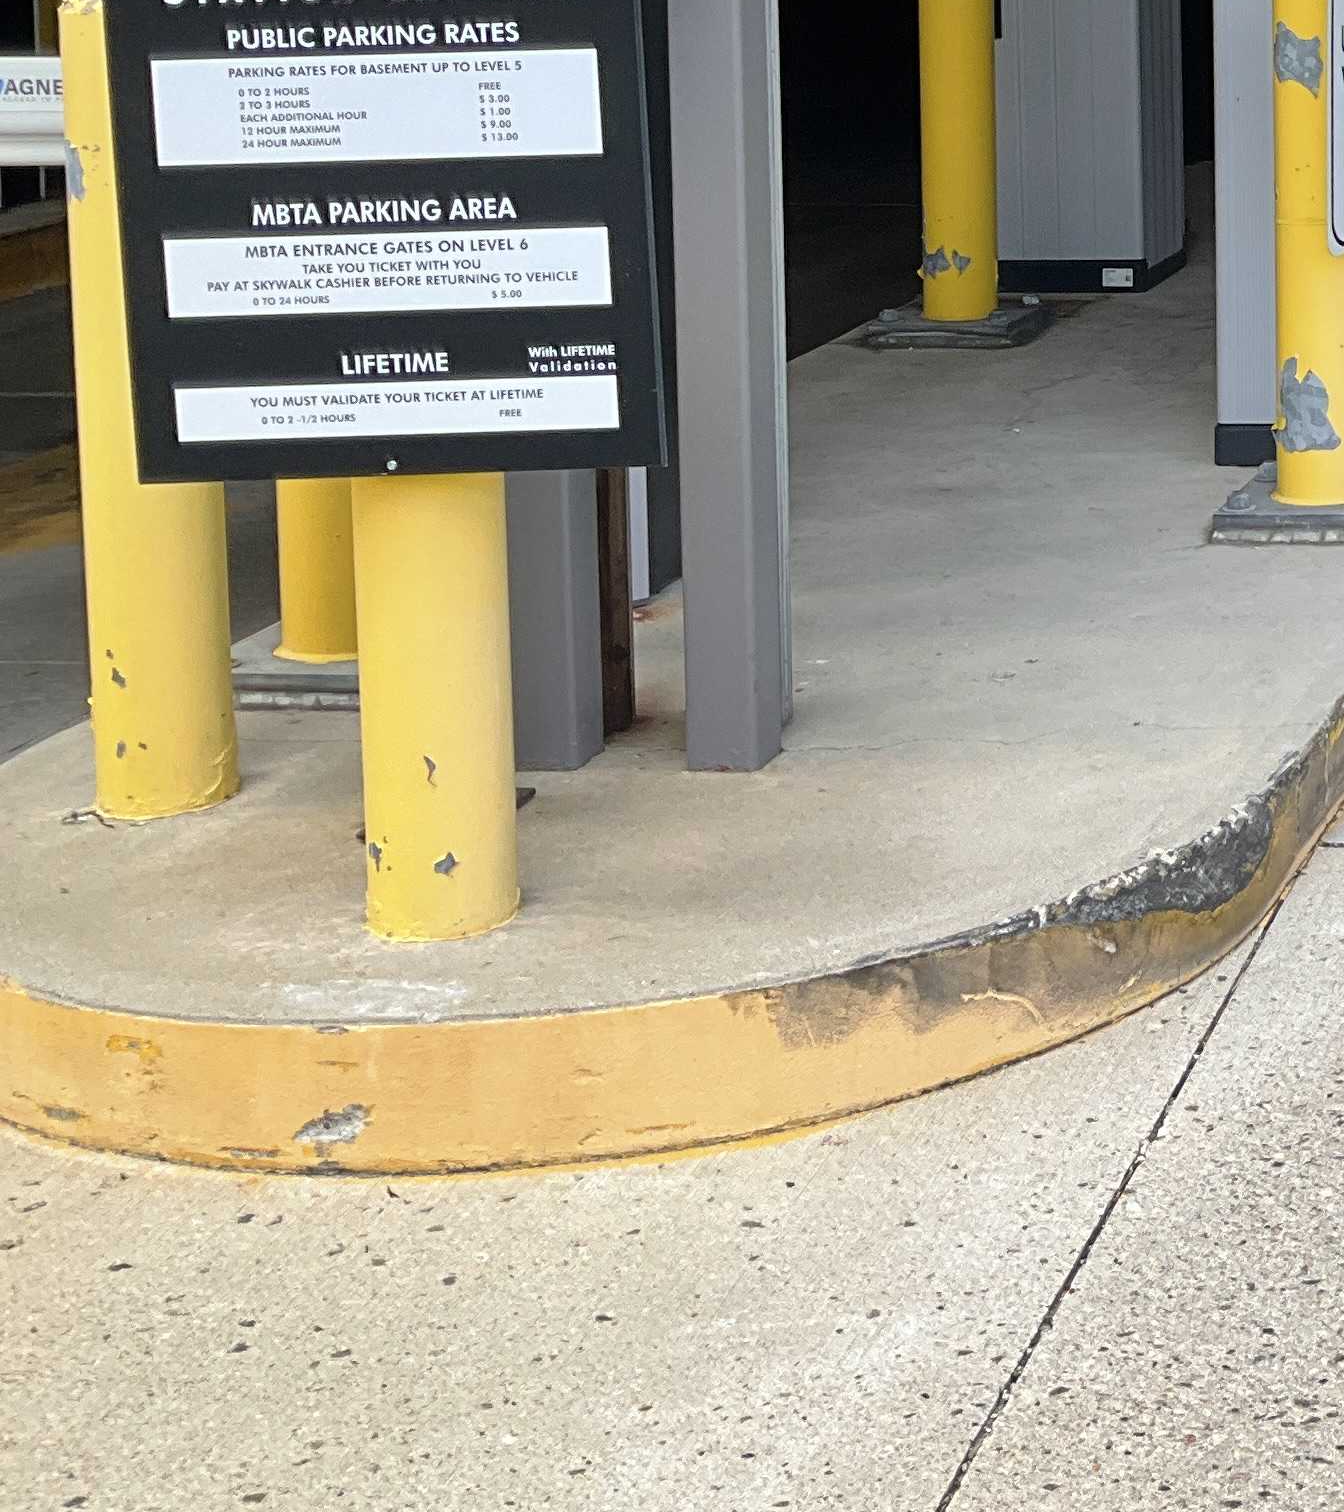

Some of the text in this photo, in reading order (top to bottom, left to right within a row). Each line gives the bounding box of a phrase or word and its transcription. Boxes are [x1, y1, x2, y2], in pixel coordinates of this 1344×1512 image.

[227, 22, 519, 49] PUBLIC PARKING RATES
[228, 60, 522, 78] PARKING RATES FOR BASEMENT UP TO LEVEL 5
[247, 88, 262, 97] TO
[273, 86, 310, 97] HOURS
[478, 81, 502, 91] FREE
[247, 100, 263, 110] TO
[274, 99, 311, 109] HOURS
[240, 110, 368, 123] EACH ADDITIONAL HOUR
[256, 125, 287, 136] HOUR
[289, 124, 341, 135] MAXIMUM
[257, 138, 288, 148] HOUR
[290, 137, 342, 147] MAXIMUM
[253, 197, 516, 225] MBTA PARKING AREA
[245, 238, 529, 258] MBTA ENTRANCE GATES ON LEVEL 6
[301, 258, 481, 275] TAKE YOU TICKET WITH YOU
[207, 270, 578, 292] PAY AT SKYWALK CASHIER BEFORE RETURNING TO VEHICLE
[261, 296, 276, 306] TO
[294, 295, 330, 305] HOURS
[527, 344, 616, 358] With LIFETIME
[342, 352, 448, 374] LIFETIME
[528, 359, 617, 373] Validation
[250, 388, 544, 408] YOU MUST VALIDATE YOUR TICKET AT LIFETIME
[270, 415, 285, 425] TO
[320, 413, 357, 423] HOURS
[499, 408, 522, 417] FREE
